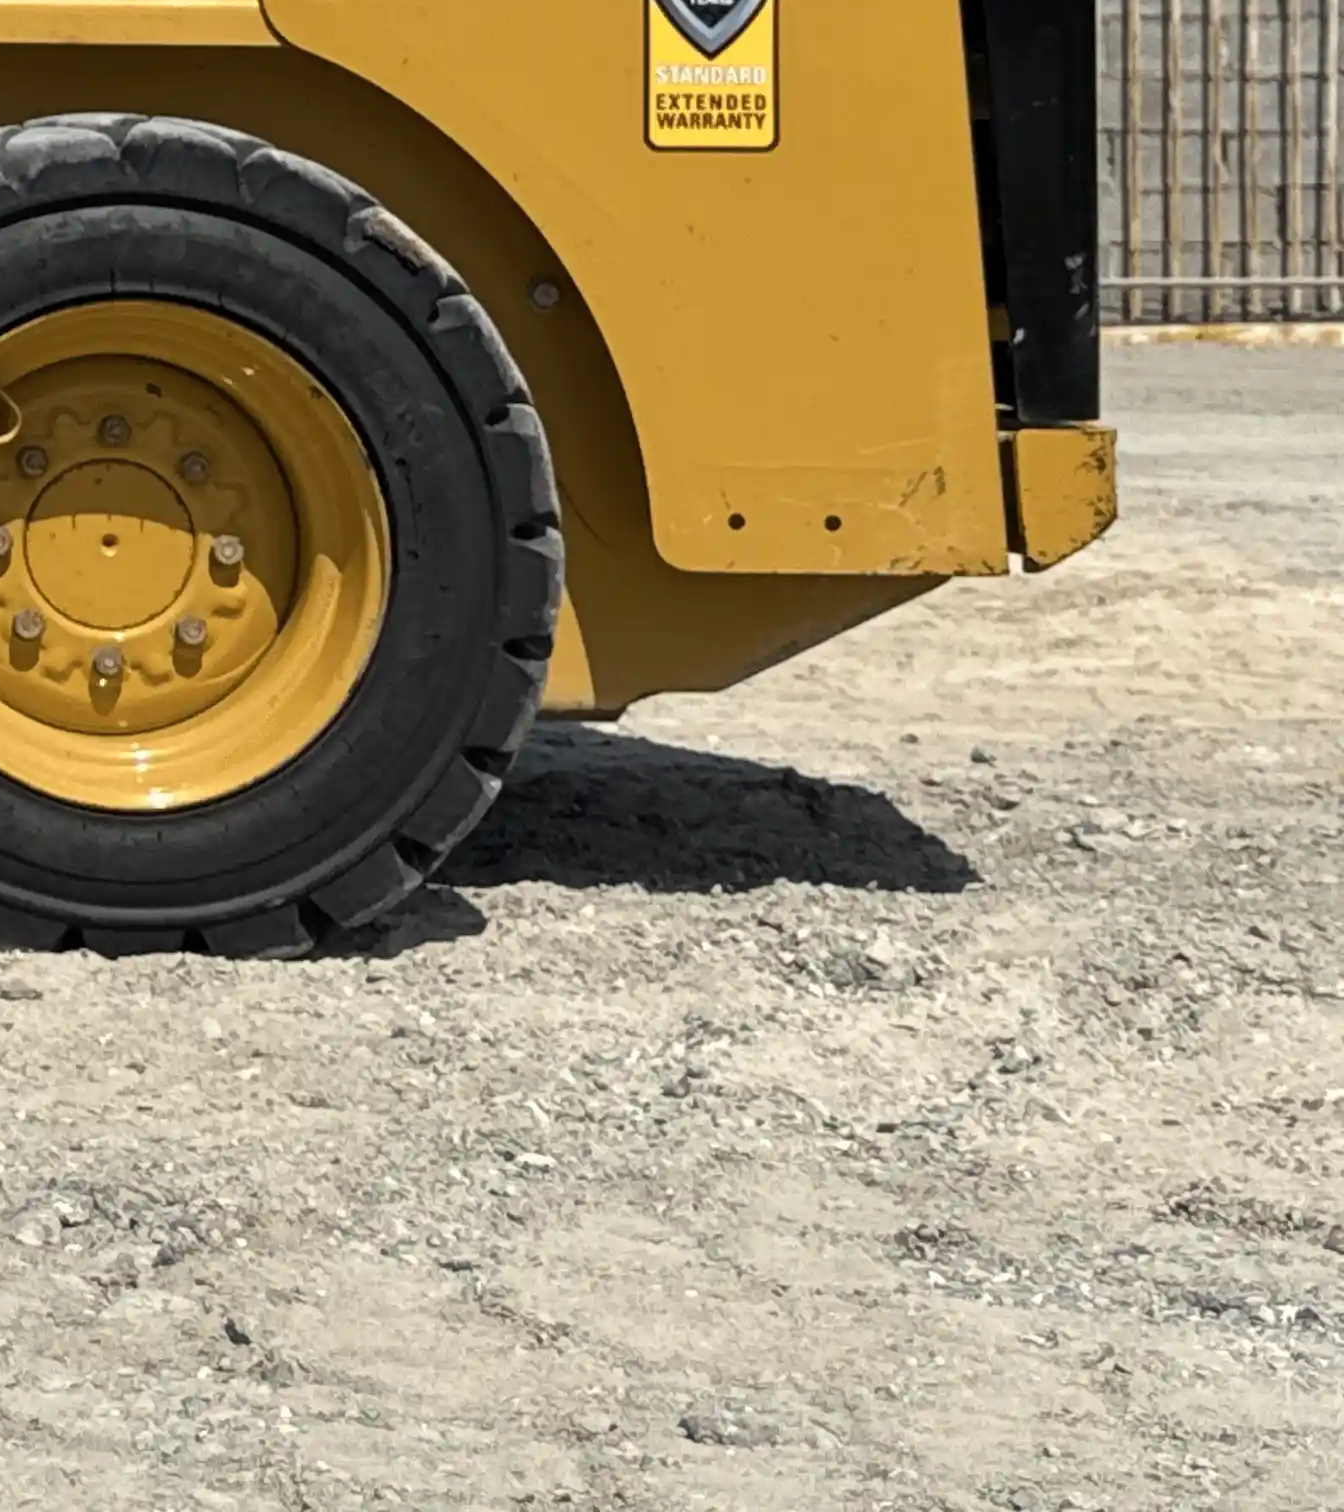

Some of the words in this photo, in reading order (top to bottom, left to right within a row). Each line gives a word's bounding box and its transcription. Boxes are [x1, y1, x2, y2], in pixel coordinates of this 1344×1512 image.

[656, 66, 767, 85] STANDARD
[656, 93, 767, 111] EXTENDED
[657, 112, 767, 130] WARRANTY
